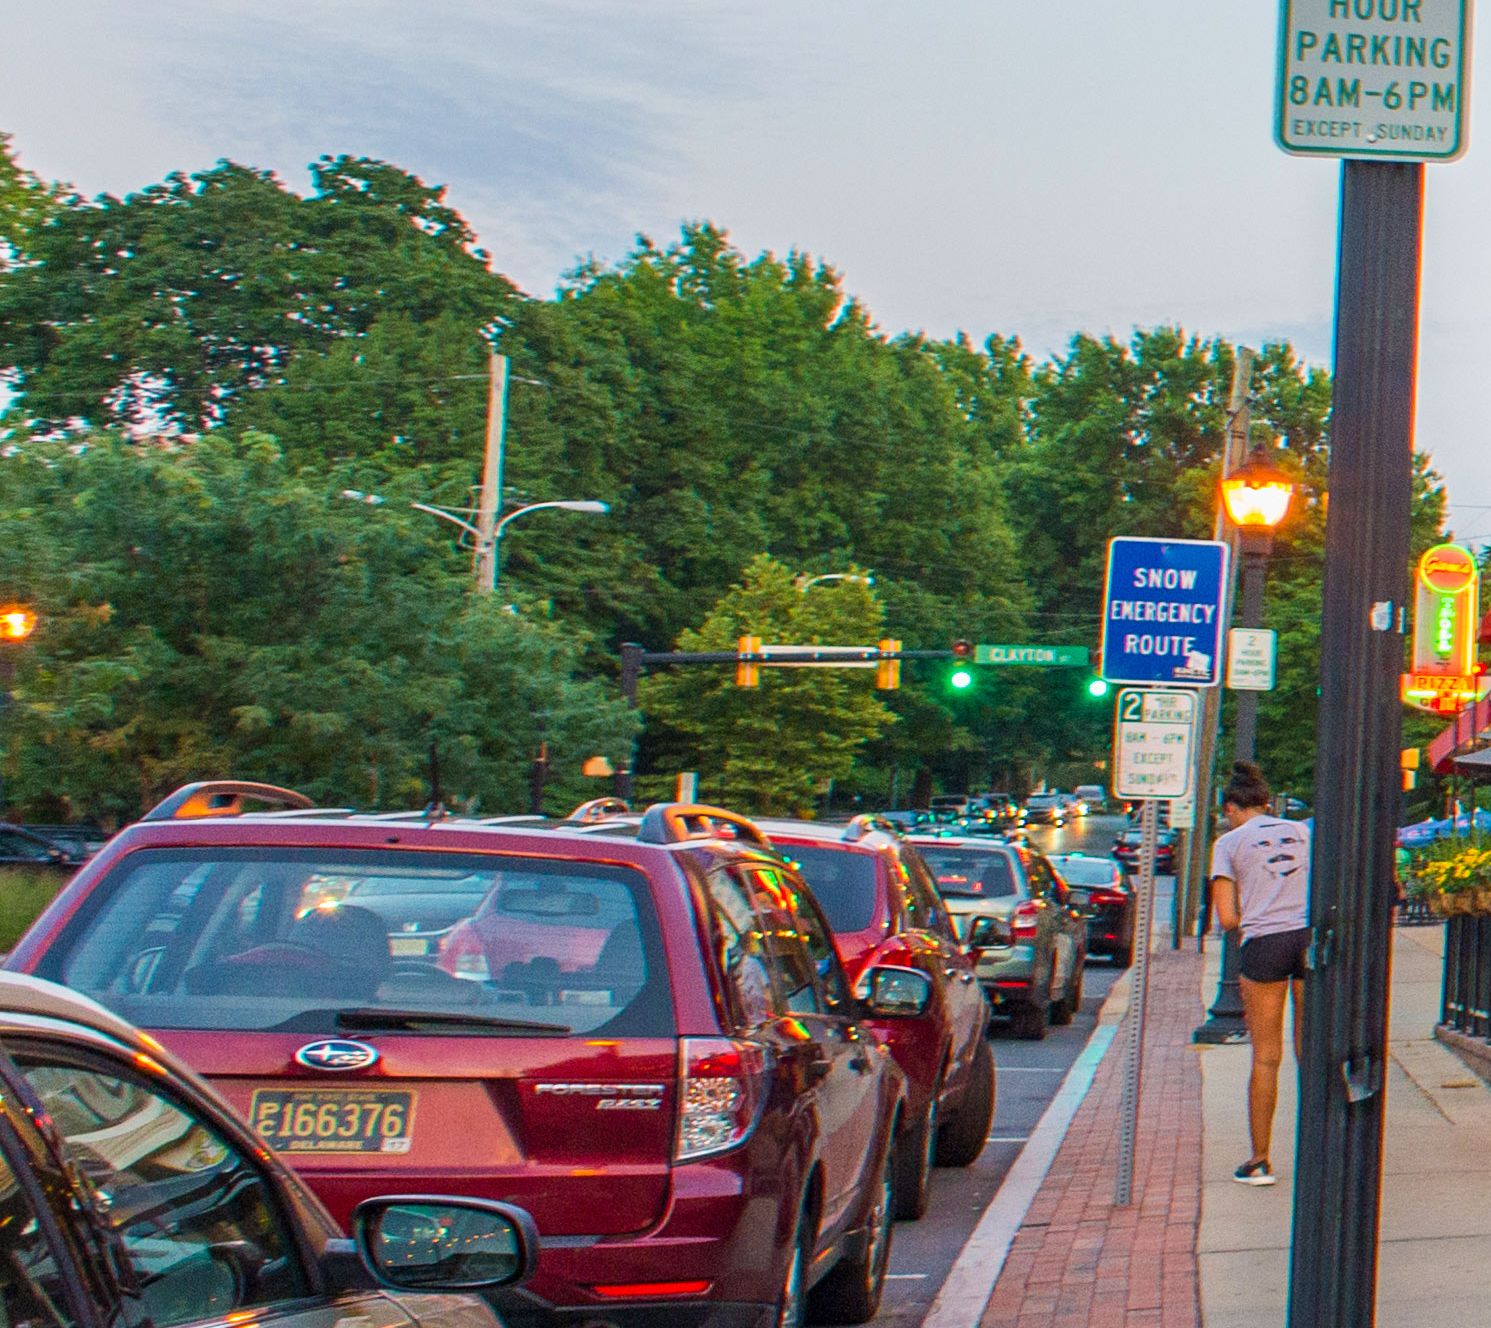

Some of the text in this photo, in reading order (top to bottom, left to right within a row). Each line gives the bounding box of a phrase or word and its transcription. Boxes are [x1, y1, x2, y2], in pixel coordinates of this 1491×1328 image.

[1297, 30, 1452, 69] PARKING
[1289, 75, 1456, 113] 8AM-6PM
[1293, 119, 1449, 142] EXCEPT SUNDAY
[1133, 567, 1198, 590] SNOW
[1110, 599, 1217, 624] EMERGENCY
[990, 649, 1054, 661] CLAYTON
[1124, 634, 1198, 657] ROUTE
[1123, 693, 1141, 720] 2
[1133, 752, 1174, 764] EXCEPT
[535, 1084, 666, 1096] FORESTER
[277, 1102, 404, 1137] 166376
